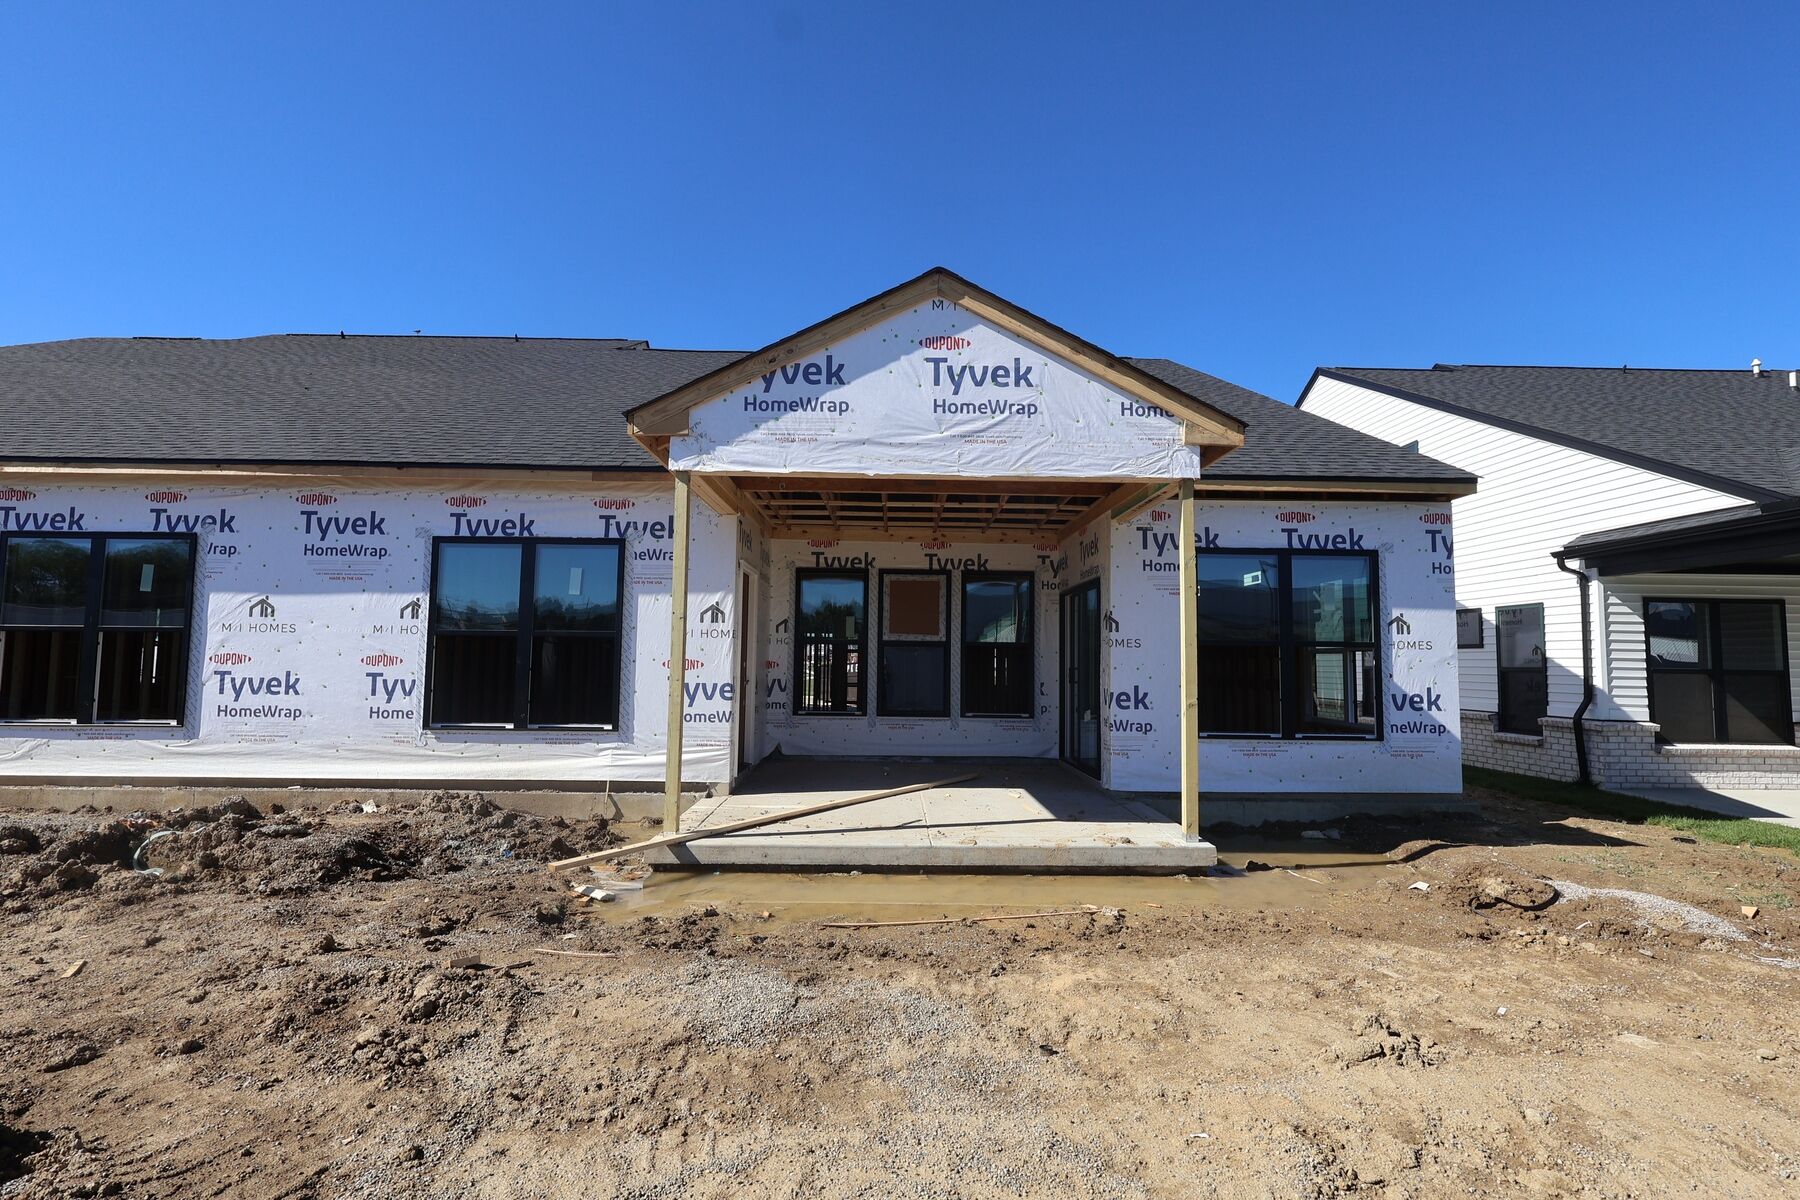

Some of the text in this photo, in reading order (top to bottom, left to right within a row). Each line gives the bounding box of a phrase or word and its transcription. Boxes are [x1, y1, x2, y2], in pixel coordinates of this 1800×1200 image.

[925, 336, 965, 350] DUPONT
[761, 355, 846, 393] yvek
[925, 357, 1034, 396] Tyvek
[744, 396, 850, 416] HomeWrap
[933, 398, 1038, 418] HomeWrap
[1121, 402, 1175, 417] Home
[150, 491, 183, 503] DUPONT
[300, 493, 333, 506] DUPONT
[450, 496, 482, 508] DUPONT
[598, 499, 631, 510] DUPONT
[1151, 510, 1166, 521] ONT
[1280, 511, 1311, 523] DUPONT
[1424, 513, 1451, 525] DUPON
[300, 511, 386, 541] Tyvek
[450, 513, 535, 536] Tyvek
[304, 544, 388, 560] HomeWrap
[249, 623, 297, 633] HOMES
[700, 628, 736, 639] HOME
[1107, 638, 1142, 649] OMES
[214, 653, 247, 665] DUPONT
[366, 654, 398, 667] DUPONT
[214, 670, 301, 702] Tyvek
[366, 672, 416, 704] Tyv
[684, 682, 736, 708] yve
[1104, 685, 1150, 710] vek
[1391, 687, 1443, 712] vek
[217, 705, 302, 721] HomeWrap
[370, 706, 414, 719] Home
[684, 710, 732, 723] omeW
[1109, 719, 1153, 735] eWrap
